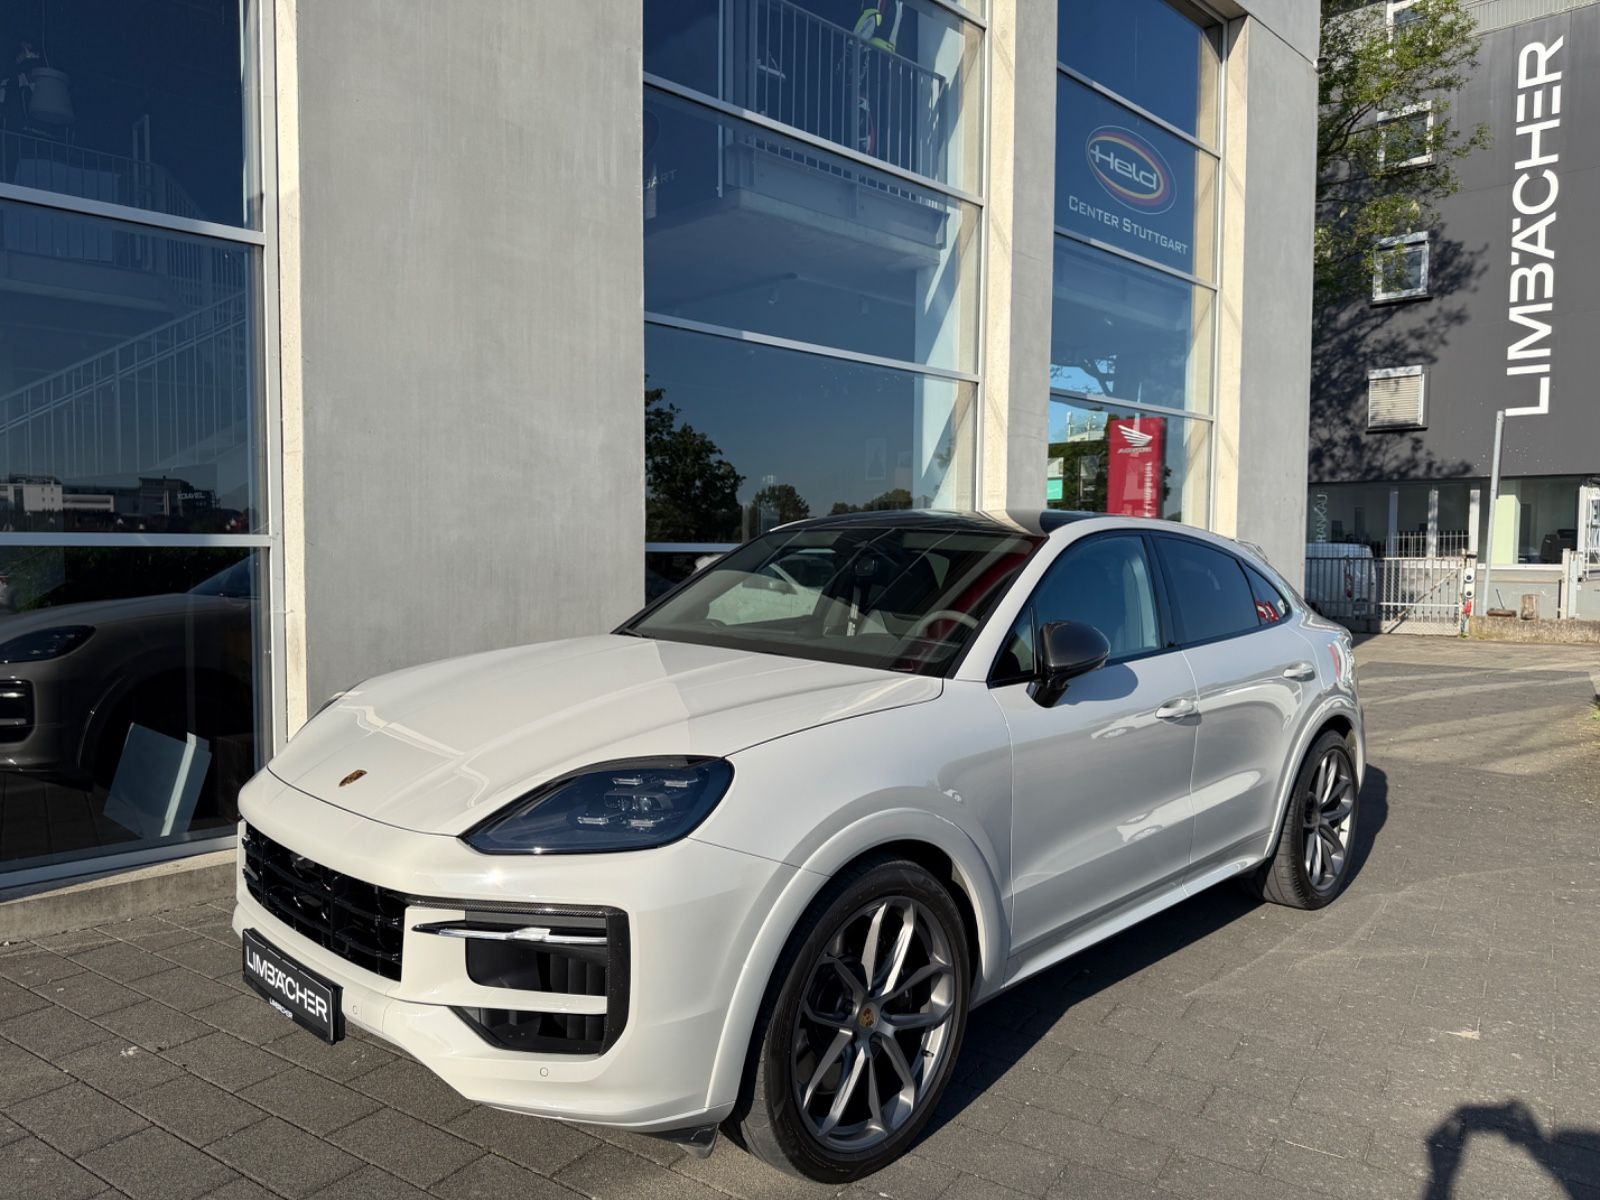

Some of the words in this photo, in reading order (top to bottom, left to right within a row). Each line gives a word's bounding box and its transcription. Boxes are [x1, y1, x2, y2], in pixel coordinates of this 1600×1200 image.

[1090, 144, 1157, 190] Held
[1505, 34, 1564, 417] LIMBÄCHER
[246, 945, 328, 1023] LIMBÄCHER
